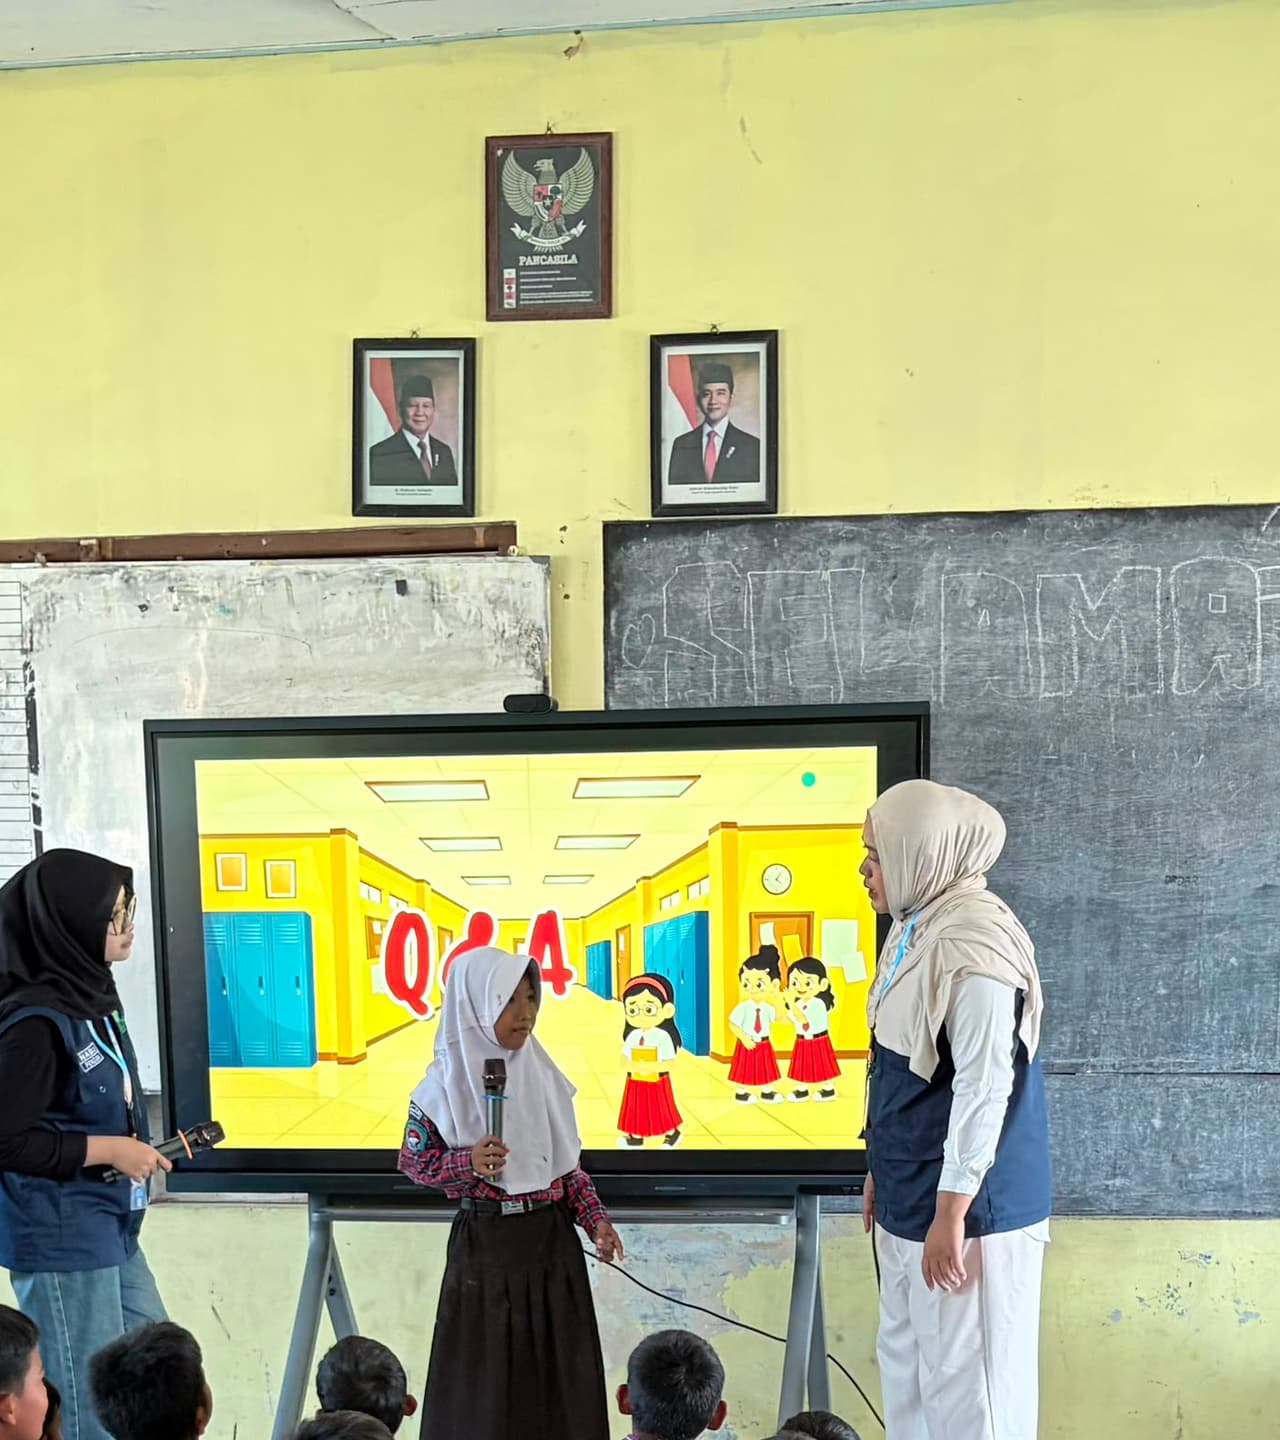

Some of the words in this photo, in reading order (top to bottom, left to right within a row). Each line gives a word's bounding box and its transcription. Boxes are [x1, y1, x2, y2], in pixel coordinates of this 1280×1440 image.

[519, 254, 578, 266] PANCASILA
[385, 911, 429, 1015] Q
[529, 910, 573, 995] A
